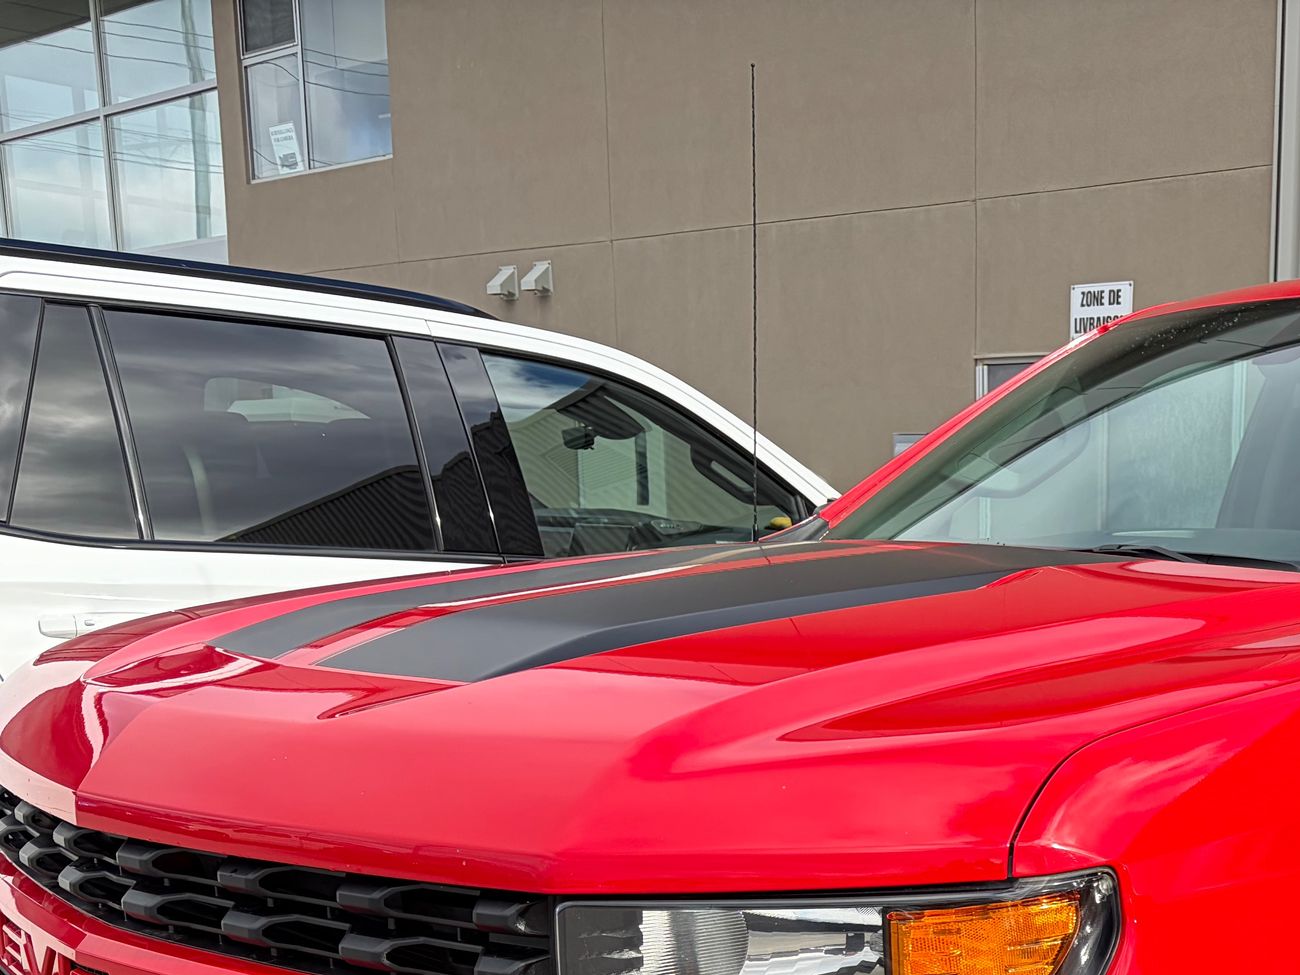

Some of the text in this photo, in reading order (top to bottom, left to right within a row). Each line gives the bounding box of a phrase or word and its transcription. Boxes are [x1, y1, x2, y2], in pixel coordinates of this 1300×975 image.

[1080, 288, 1122, 308] ZONE DE
[1074, 315, 1124, 334] LIVRAI
